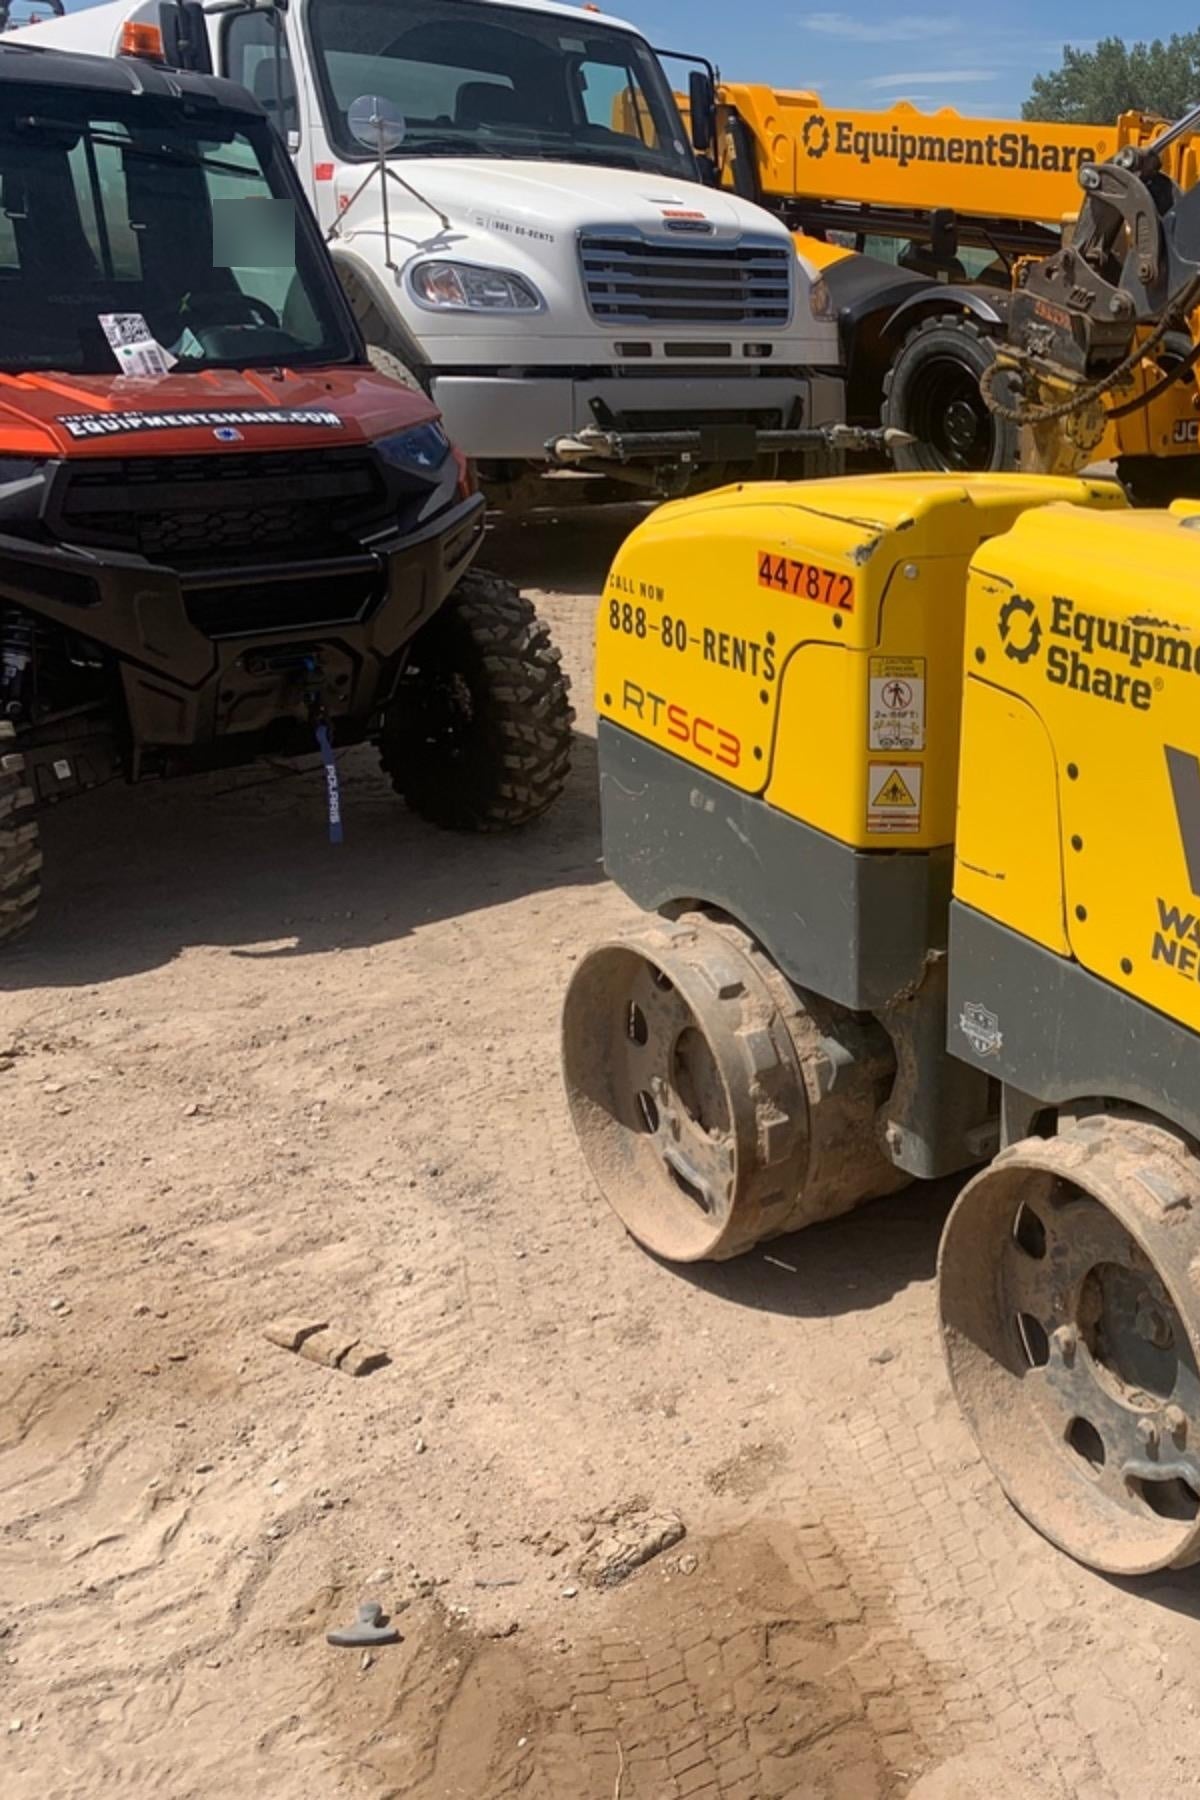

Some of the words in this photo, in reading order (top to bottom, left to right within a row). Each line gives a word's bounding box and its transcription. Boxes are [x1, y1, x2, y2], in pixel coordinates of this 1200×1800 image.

[835, 121, 1096, 172] EquipmentShare
[66, 412, 341, 436] EQUIPMENTSHARE.COM
[609, 573, 635, 594] CALL
[639, 581, 665, 602] NOW
[759, 553, 854, 610] 447872
[609, 599, 776, 682] 888-80-RENTS
